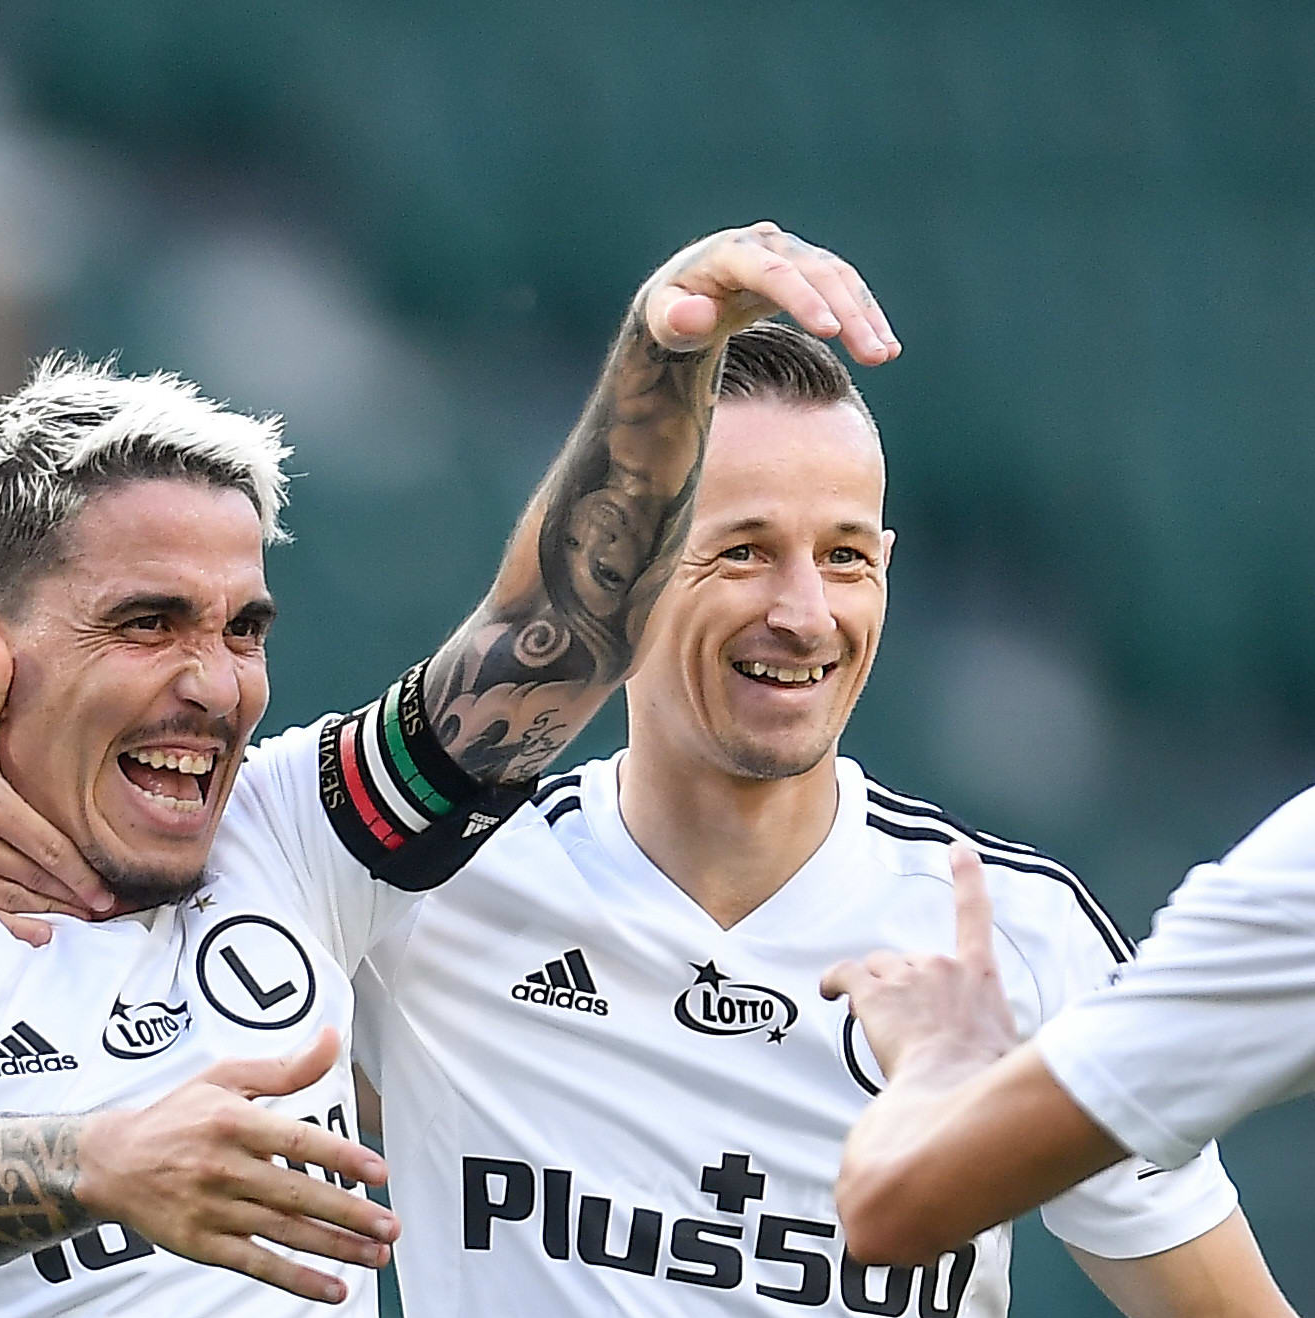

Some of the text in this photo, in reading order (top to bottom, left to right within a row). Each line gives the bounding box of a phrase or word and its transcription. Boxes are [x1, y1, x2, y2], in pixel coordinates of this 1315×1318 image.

[510, 982, 609, 1017] adidas
[702, 989, 774, 1024] LOTTO
[115, 1015, 180, 1048] LOTTO
